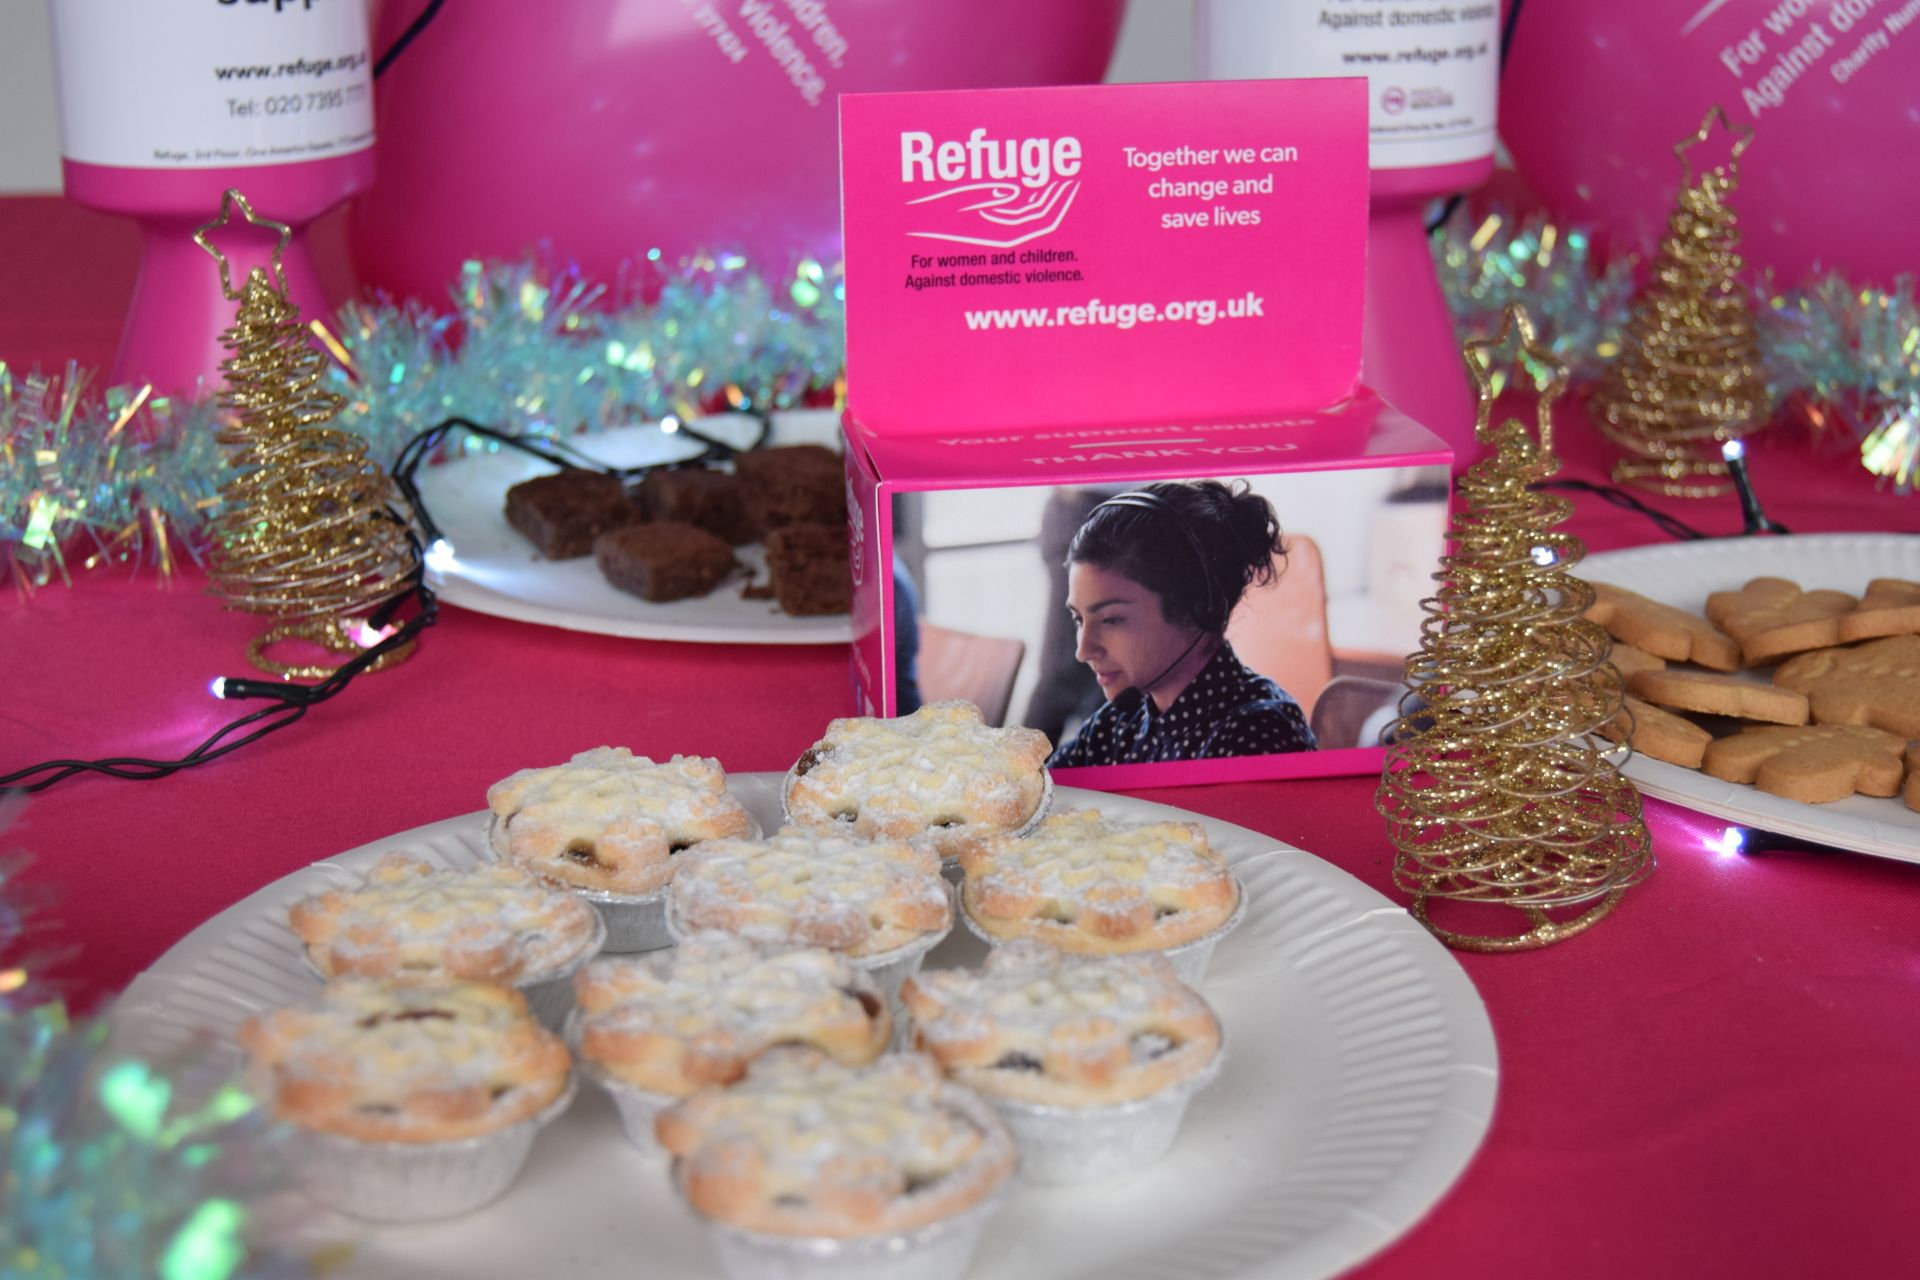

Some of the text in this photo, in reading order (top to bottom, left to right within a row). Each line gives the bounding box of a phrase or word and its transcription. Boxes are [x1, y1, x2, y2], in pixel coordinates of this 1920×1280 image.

[1318, 10, 1383, 30] Against
[1389, 8, 1456, 27] domestic
[1719, 0, 1815, 78] For wo
[1741, 0, 1875, 118] Against do
[227, 98, 259, 116] Tel:
[264, 94, 302, 115] 020
[901, 128, 1082, 188] Refuge
[1123, 145, 1298, 171] Together we can
[1148, 173, 1273, 201] change and
[1161, 206, 1261, 228] save lives
[911, 249, 1078, 268] For women and children.
[905, 268, 1084, 291] Against domestic violence.
[965, 292, 1264, 329] www.refuge.org.uk
[937, 418, 1317, 446] Your support counts
[1022, 443, 1299, 465] THANK YOU
